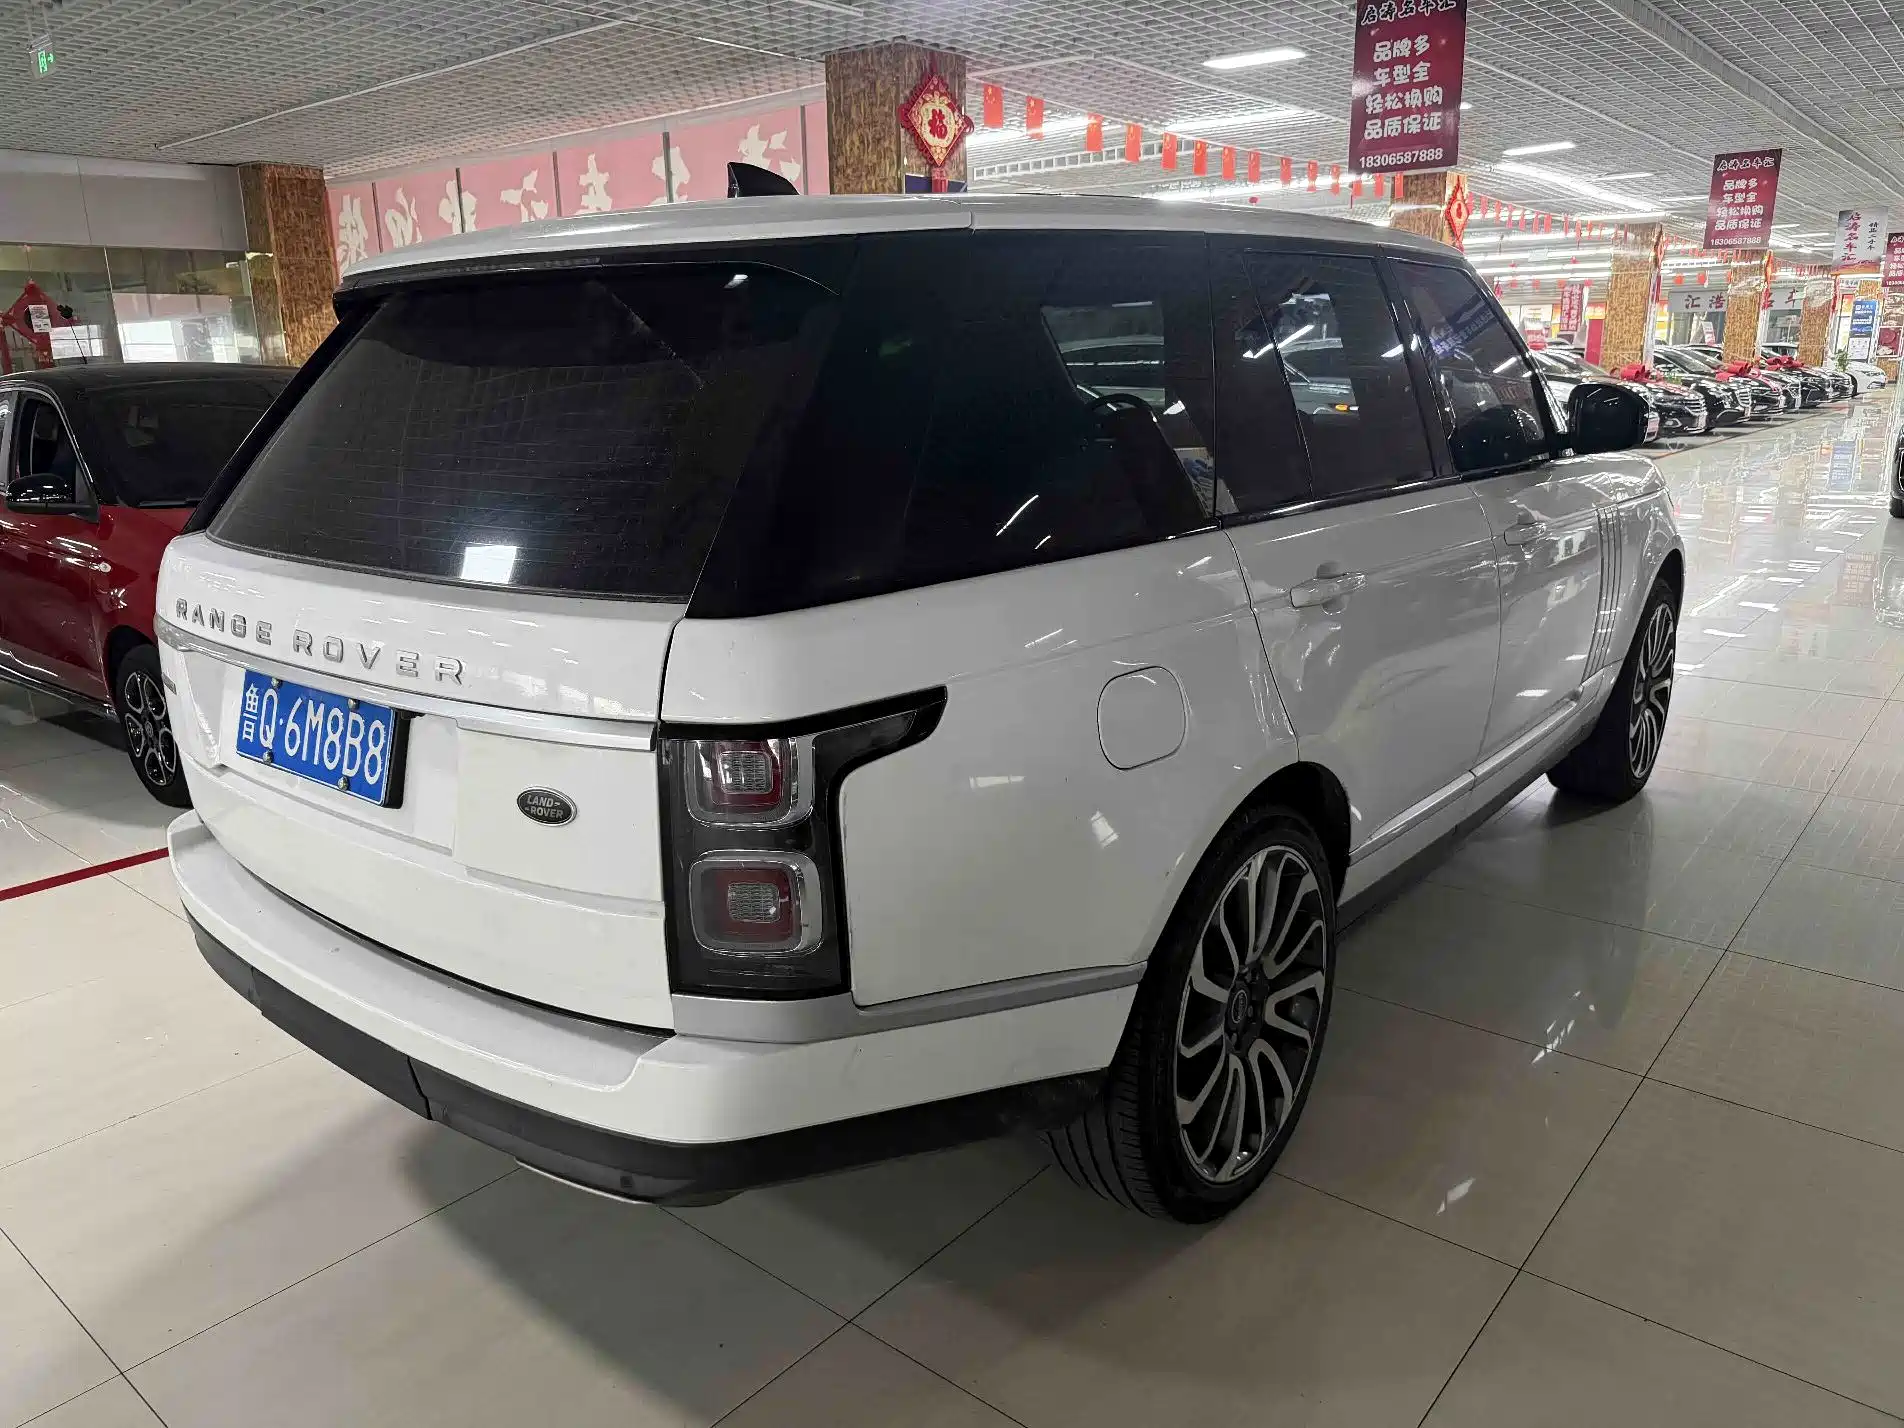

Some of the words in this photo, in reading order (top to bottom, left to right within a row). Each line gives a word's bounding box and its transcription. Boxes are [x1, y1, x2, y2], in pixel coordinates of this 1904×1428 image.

[1373, 34, 1430, 62] 品牌多
[1373, 60, 1431, 88] 车型全
[1365, 85, 1443, 114] 轻松换购
[1364, 111, 1442, 140] 品质保证
[1359, 148, 1444, 168] 18306587888
[175, 597, 273, 646] RANGE
[292, 629, 465, 686] ROVER
